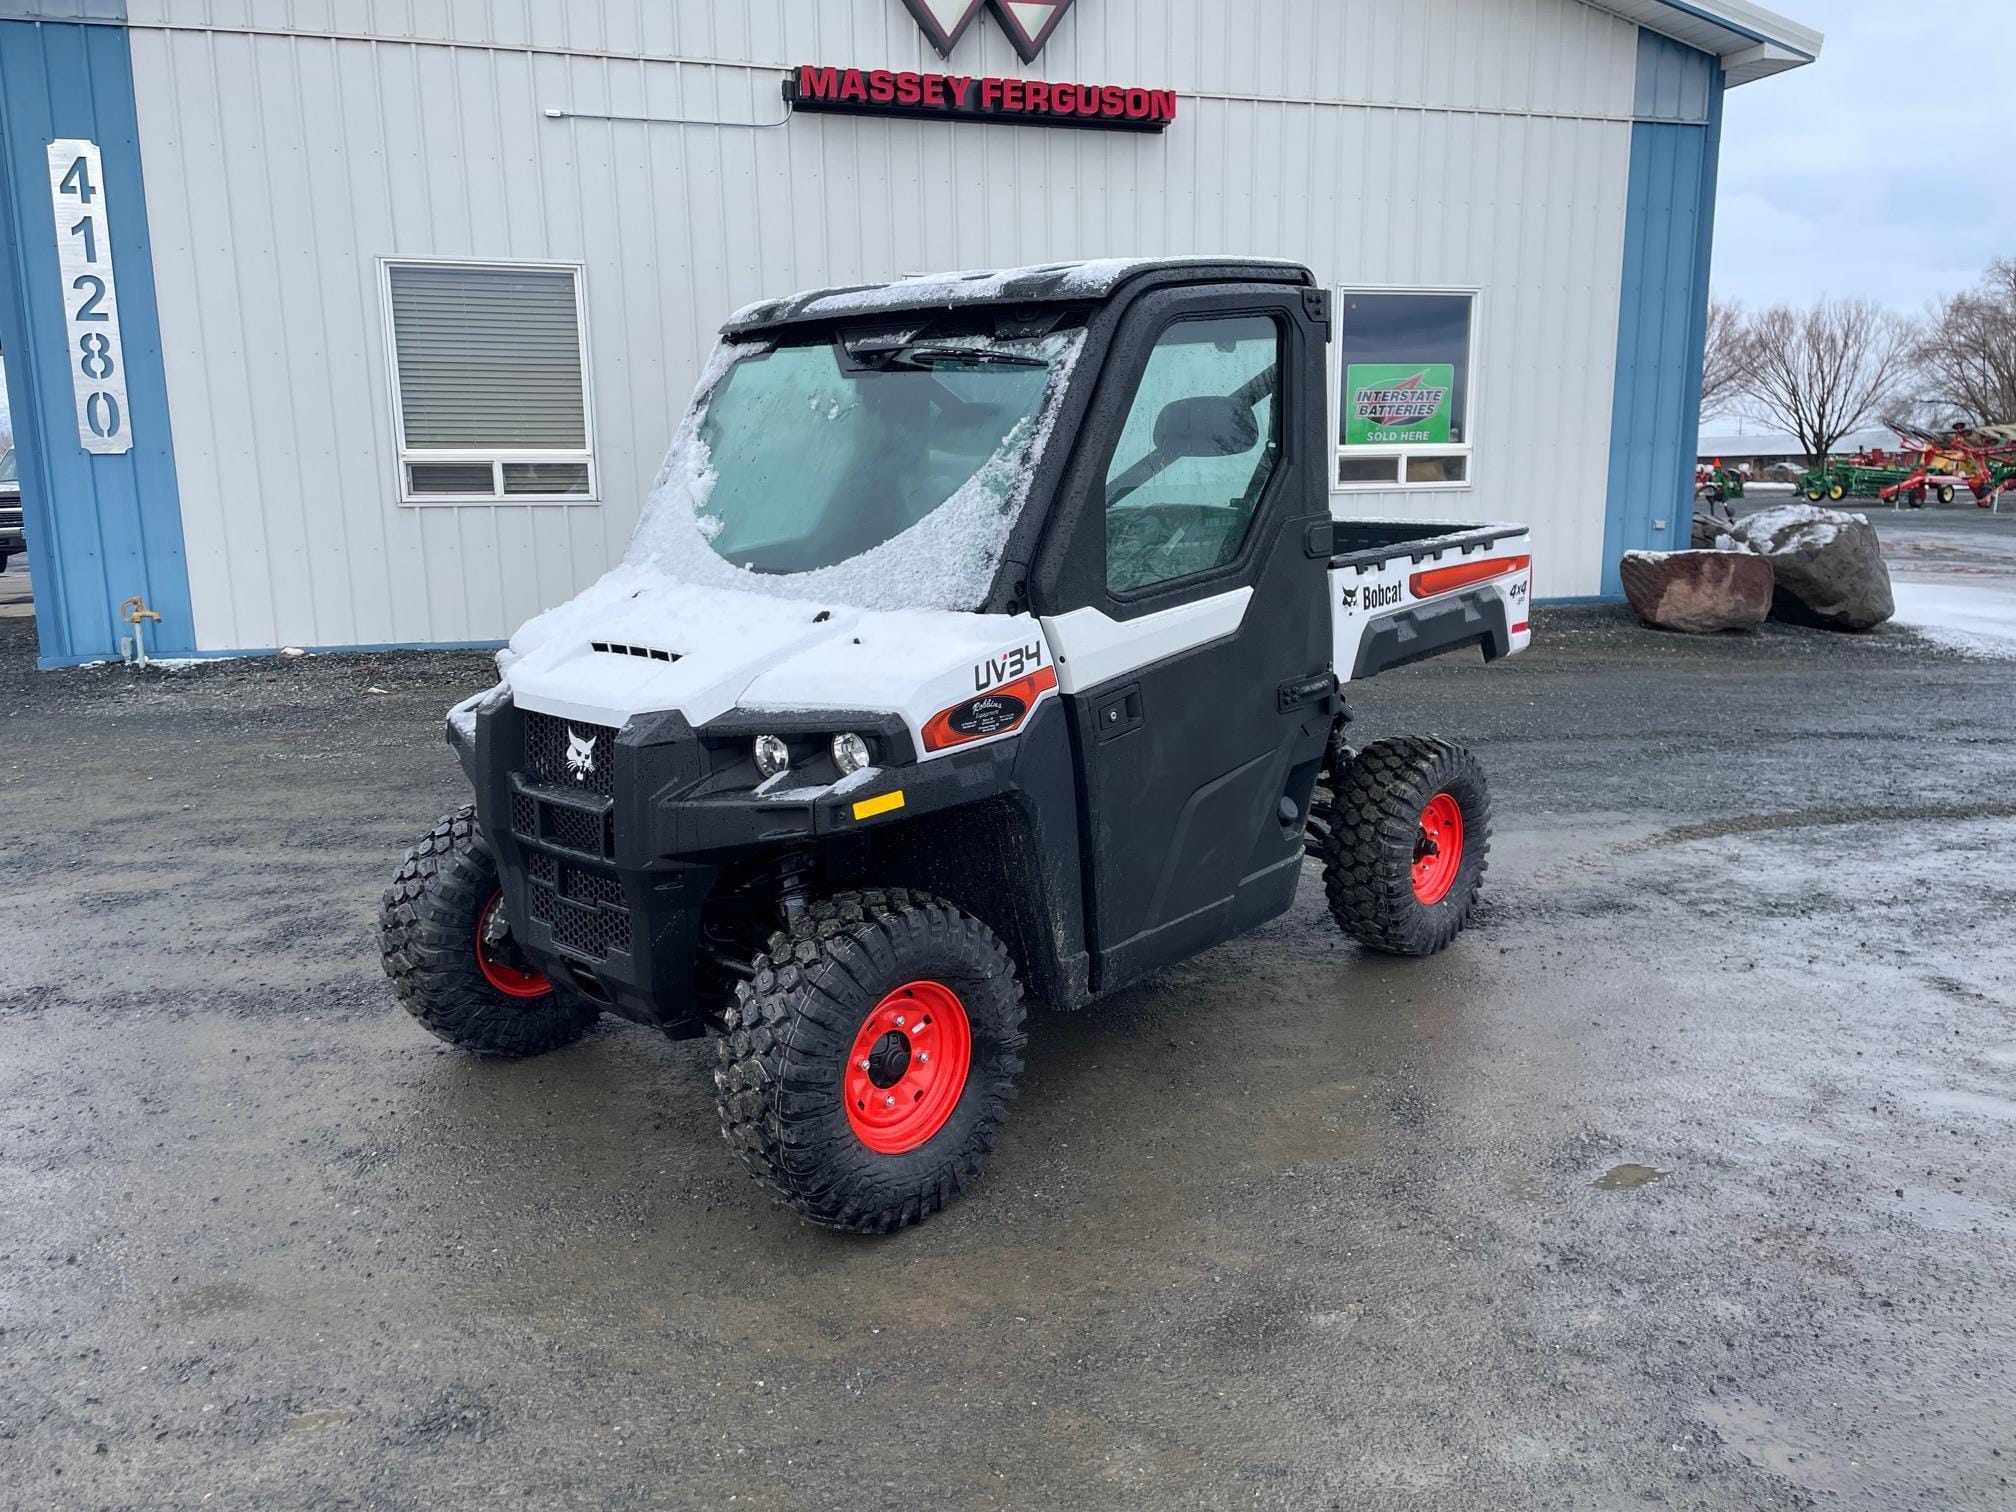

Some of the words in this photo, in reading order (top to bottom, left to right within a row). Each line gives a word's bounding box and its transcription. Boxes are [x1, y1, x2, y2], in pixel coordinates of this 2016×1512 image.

[801, 65, 972, 107] MASSEY
[980, 78, 1176, 120] FERGUSON
[59, 156, 121, 438] 41280
[1357, 390, 1442, 402] INTERSTATE
[1359, 404, 1435, 416] BATTERIES
[1366, 431, 1397, 441] SOLD
[1400, 431, 1430, 441] HERE
[1363, 580, 1402, 610] Bobcat
[1509, 580, 1527, 599] 4x4
[974, 640, 1041, 692] UV34
[972, 698, 1002, 715] Robbins
